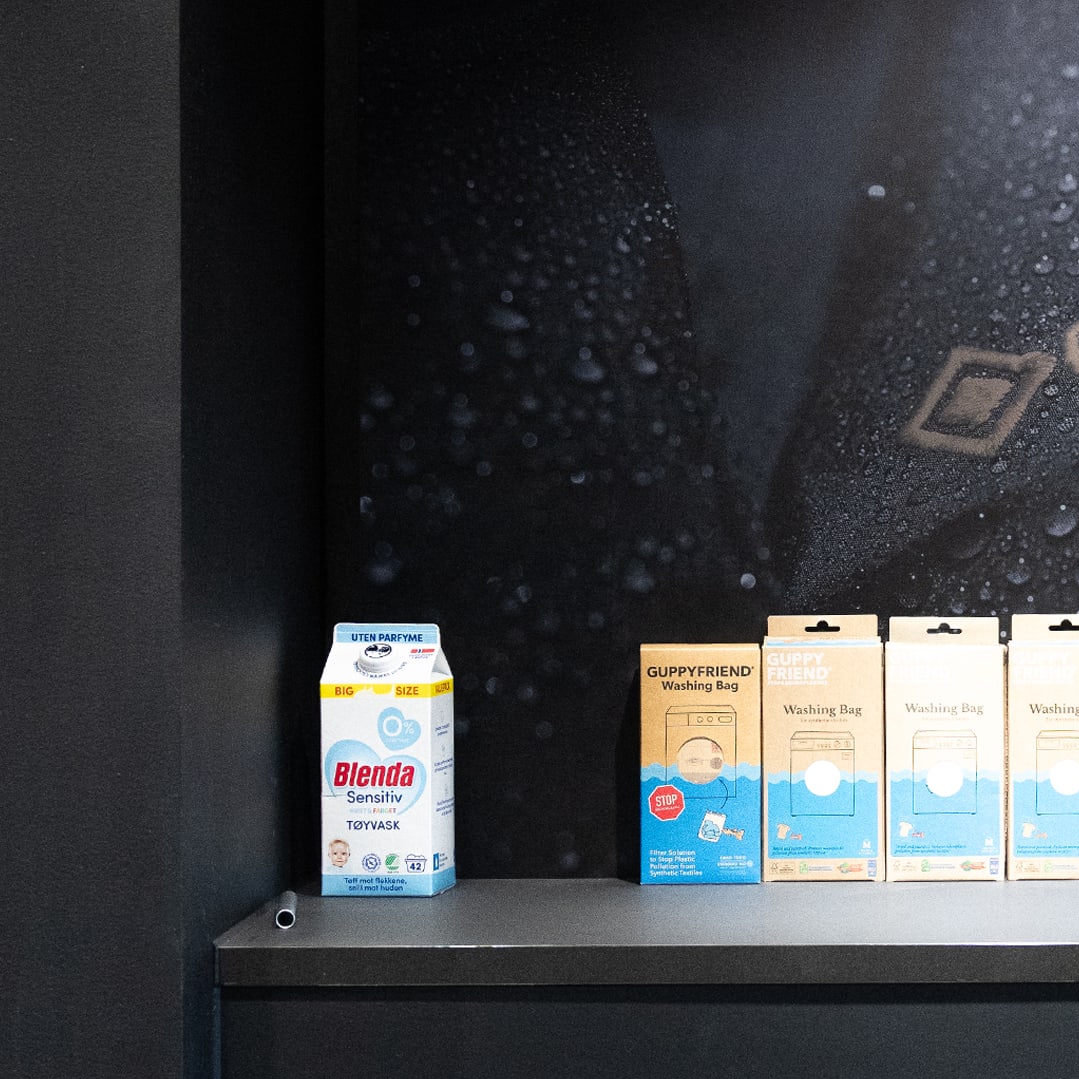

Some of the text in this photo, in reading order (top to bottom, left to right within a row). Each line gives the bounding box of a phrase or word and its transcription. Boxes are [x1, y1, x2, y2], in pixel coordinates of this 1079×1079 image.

[351, 633, 423, 642] UTEN PARFYME
[766, 652, 824, 666] GUPPY
[335, 686, 419, 696] BIG SIZE
[661, 680, 739, 692] Washing Bag
[784, 704, 862, 717] Washing Bag
[904, 702, 984, 716] Washing Bag
[333, 762, 415, 787] Blenda
[347, 790, 402, 804] Sensitiv
[655, 794, 677, 806] STOP
[346, 819, 400, 830] TØYVASK
[410, 863, 422, 871] 42
